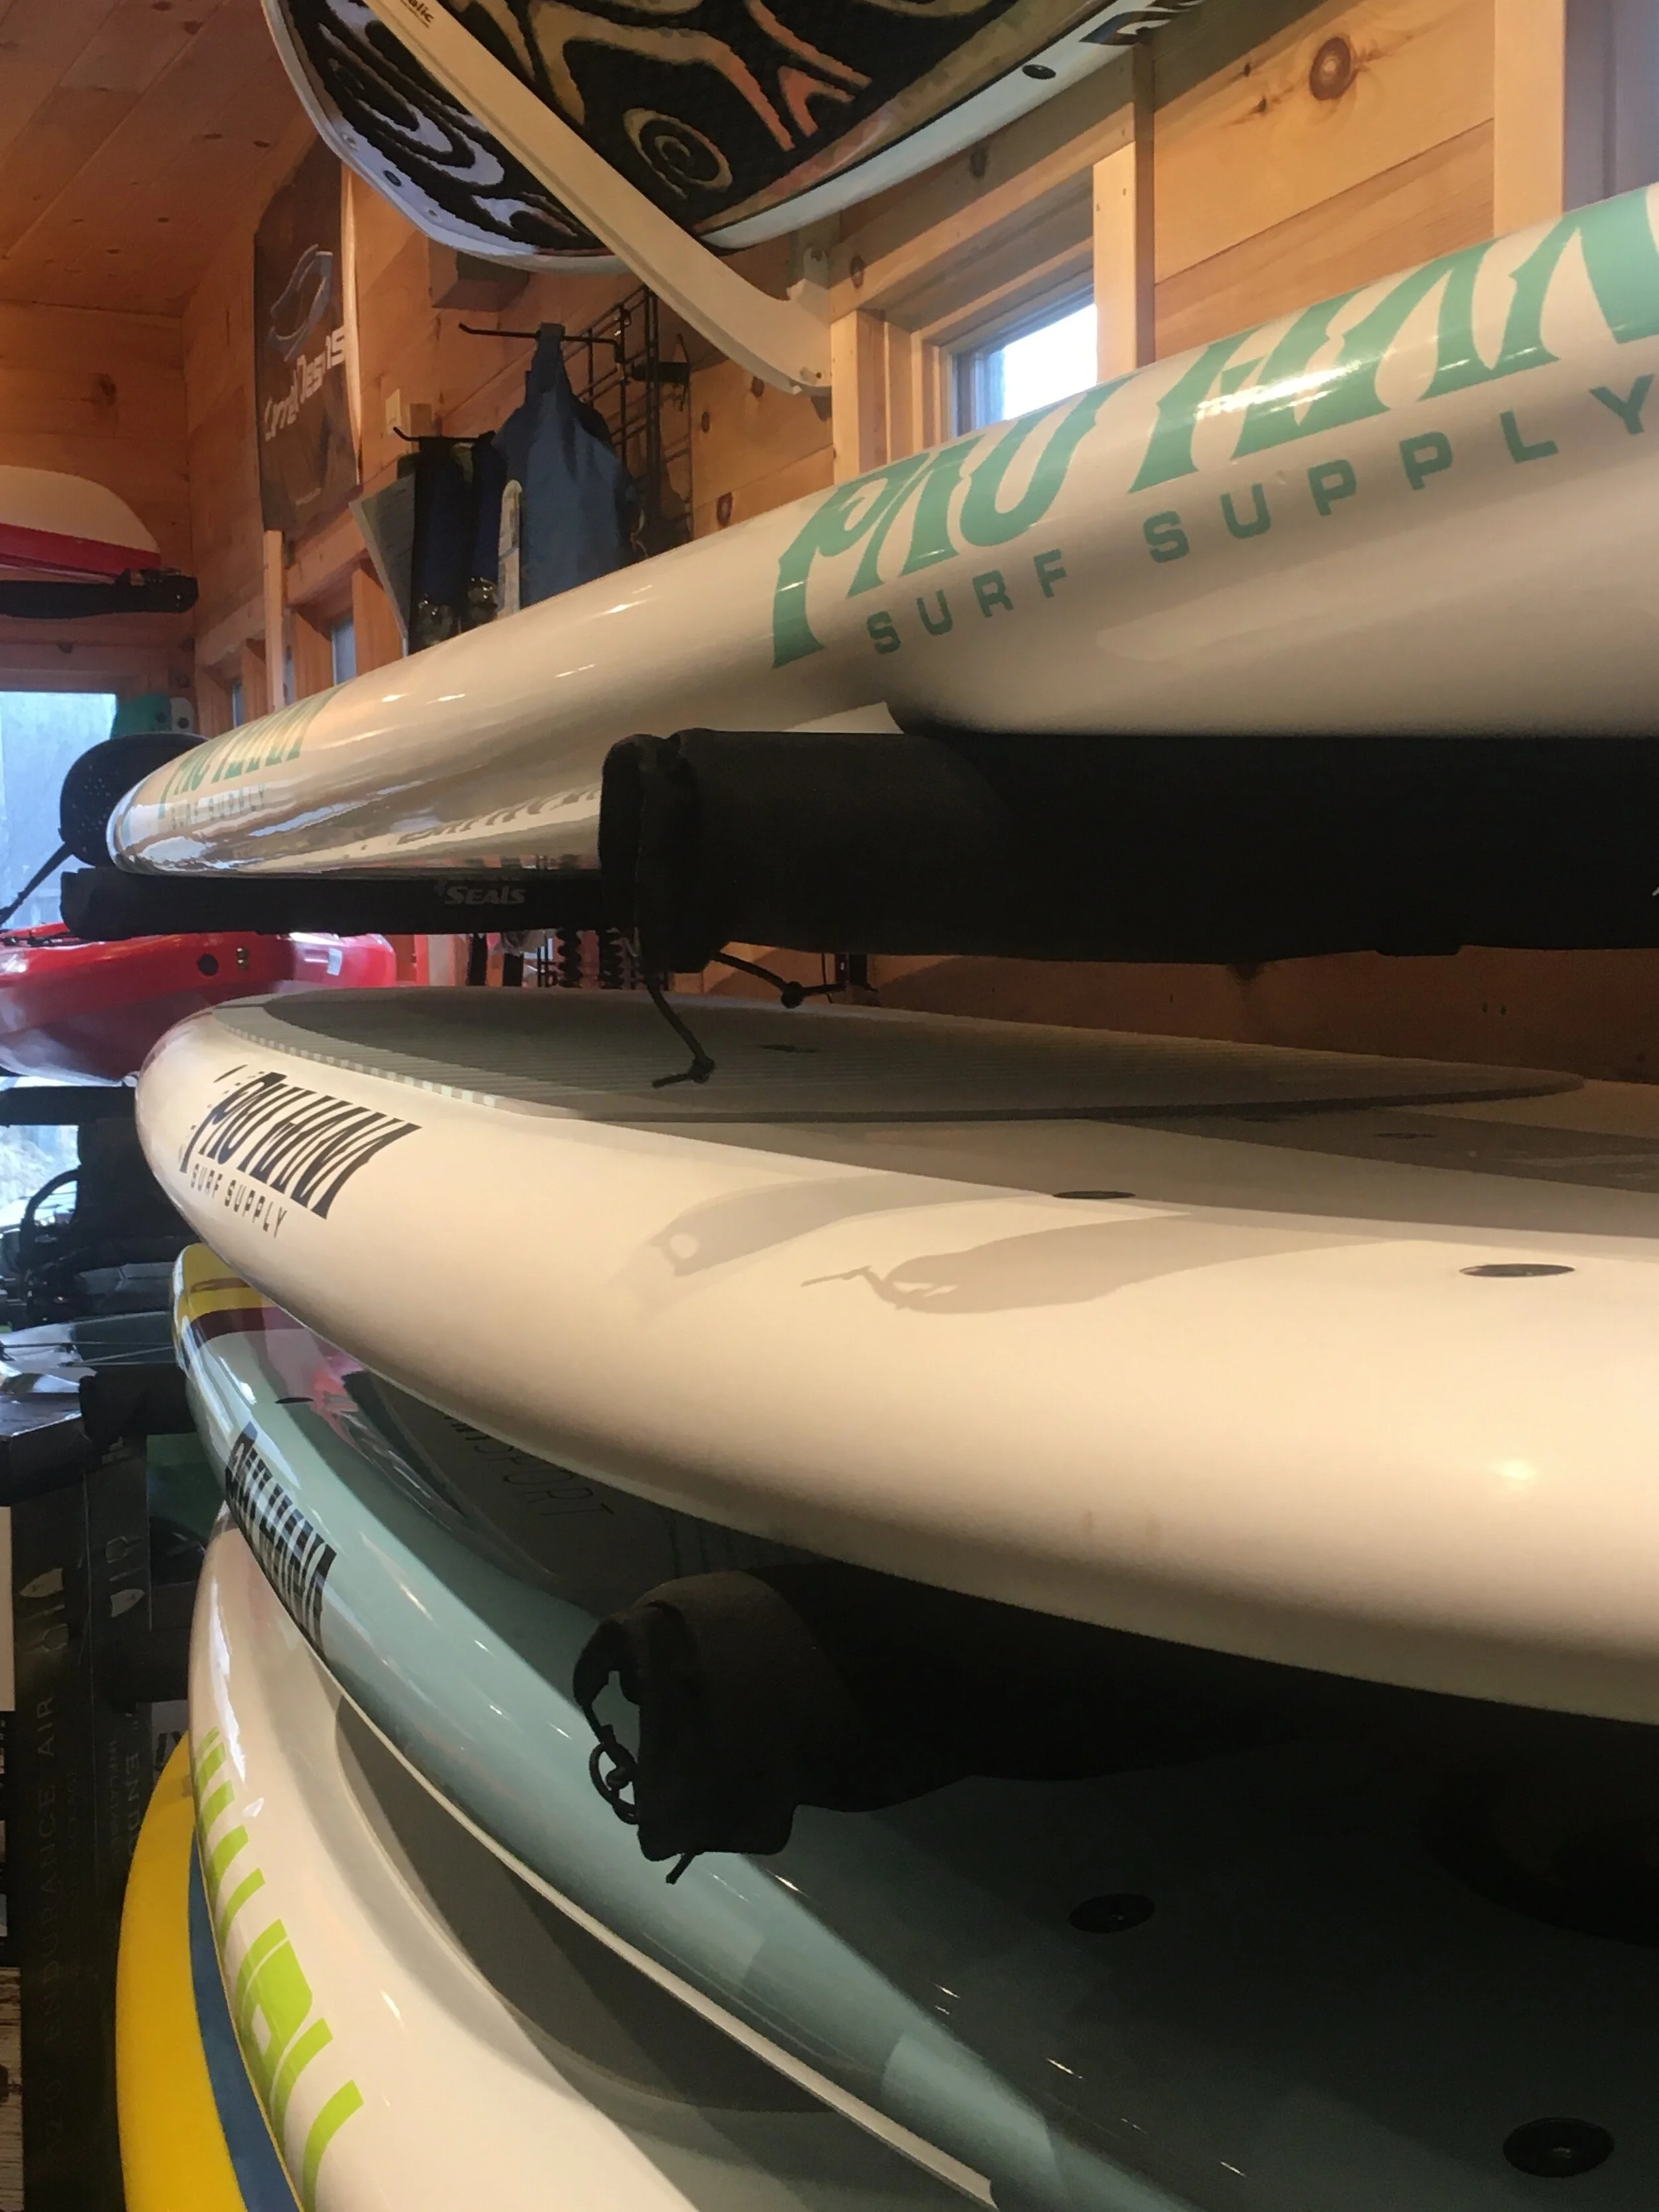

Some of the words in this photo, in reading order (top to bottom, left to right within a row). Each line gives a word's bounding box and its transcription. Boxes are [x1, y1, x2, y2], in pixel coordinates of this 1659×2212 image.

[866, 548, 1066, 654] SURF
[1142, 374, 1655, 563] SUPPLY
[190, 1162, 223, 1199] SURF
[224, 1179, 287, 1238] SUPPLY
[36, 1694, 55, 1757] AIR
